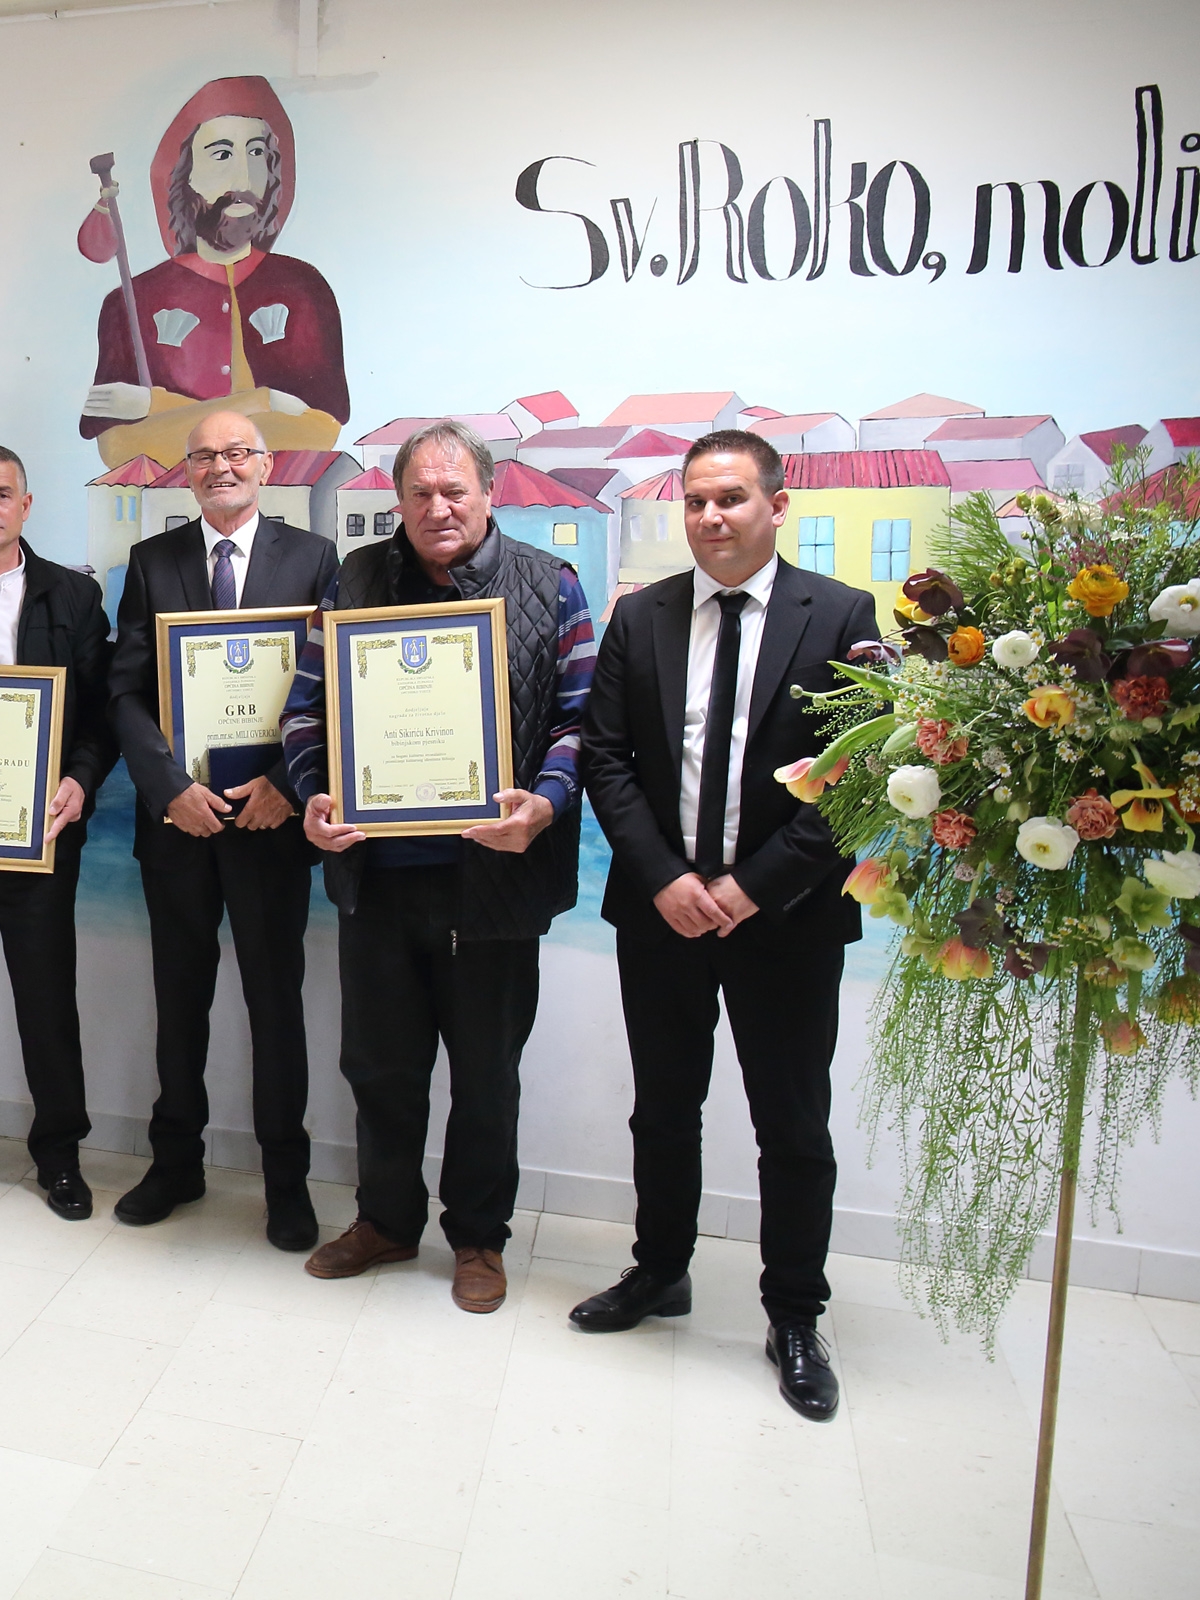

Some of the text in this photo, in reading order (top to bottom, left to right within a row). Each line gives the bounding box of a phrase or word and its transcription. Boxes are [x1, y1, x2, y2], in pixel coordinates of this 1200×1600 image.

[966, 84, 1200, 275] moli
[225, 703, 257, 717] GRB
[383, 728, 397, 739] Anti
[425, 726, 454, 738] Krivinon
